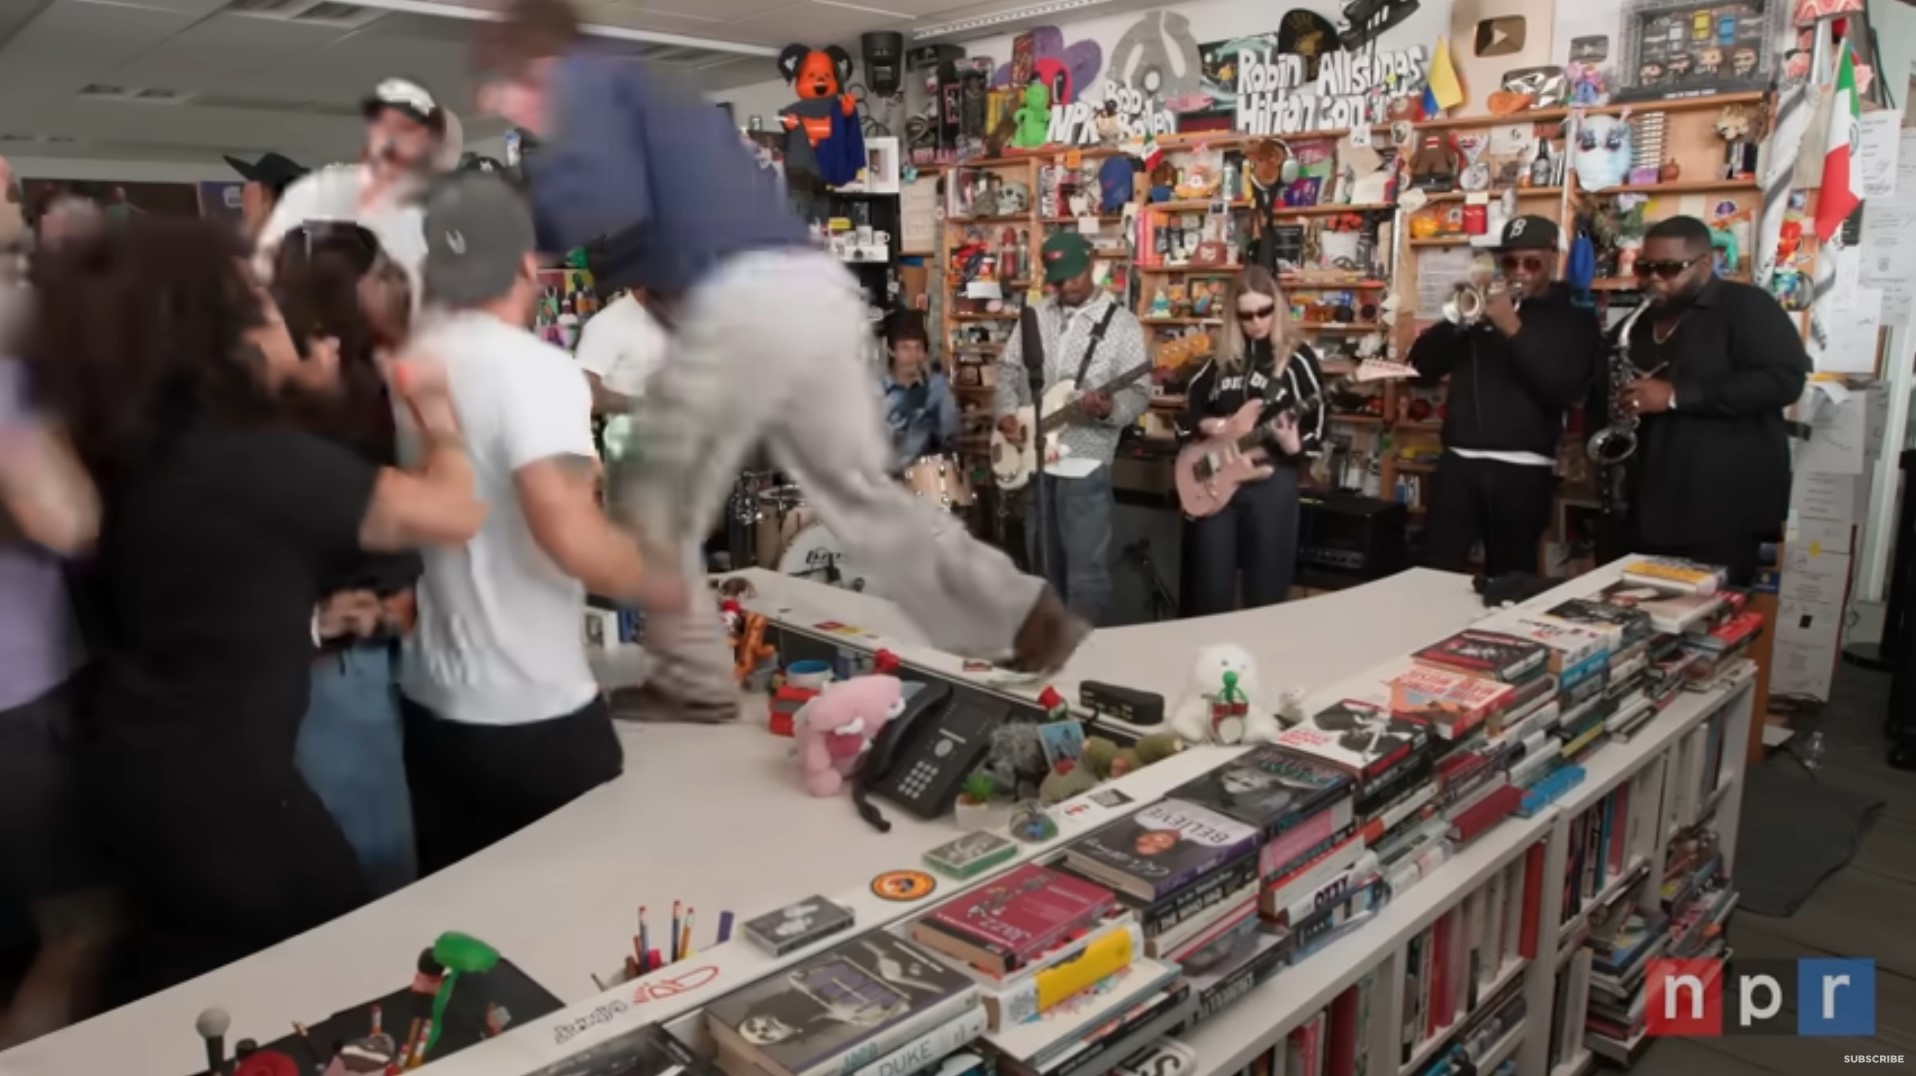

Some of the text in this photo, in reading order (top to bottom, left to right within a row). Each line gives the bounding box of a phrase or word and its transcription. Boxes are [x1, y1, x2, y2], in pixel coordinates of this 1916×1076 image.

[1237, 49, 1301, 95] Robin
[1104, 79, 1142, 114] Bob
[1236, 88, 1316, 136] Hilton
[1149, 808, 1230, 843] BELIEVE
[877, 1038, 933, 1076] DUKE
